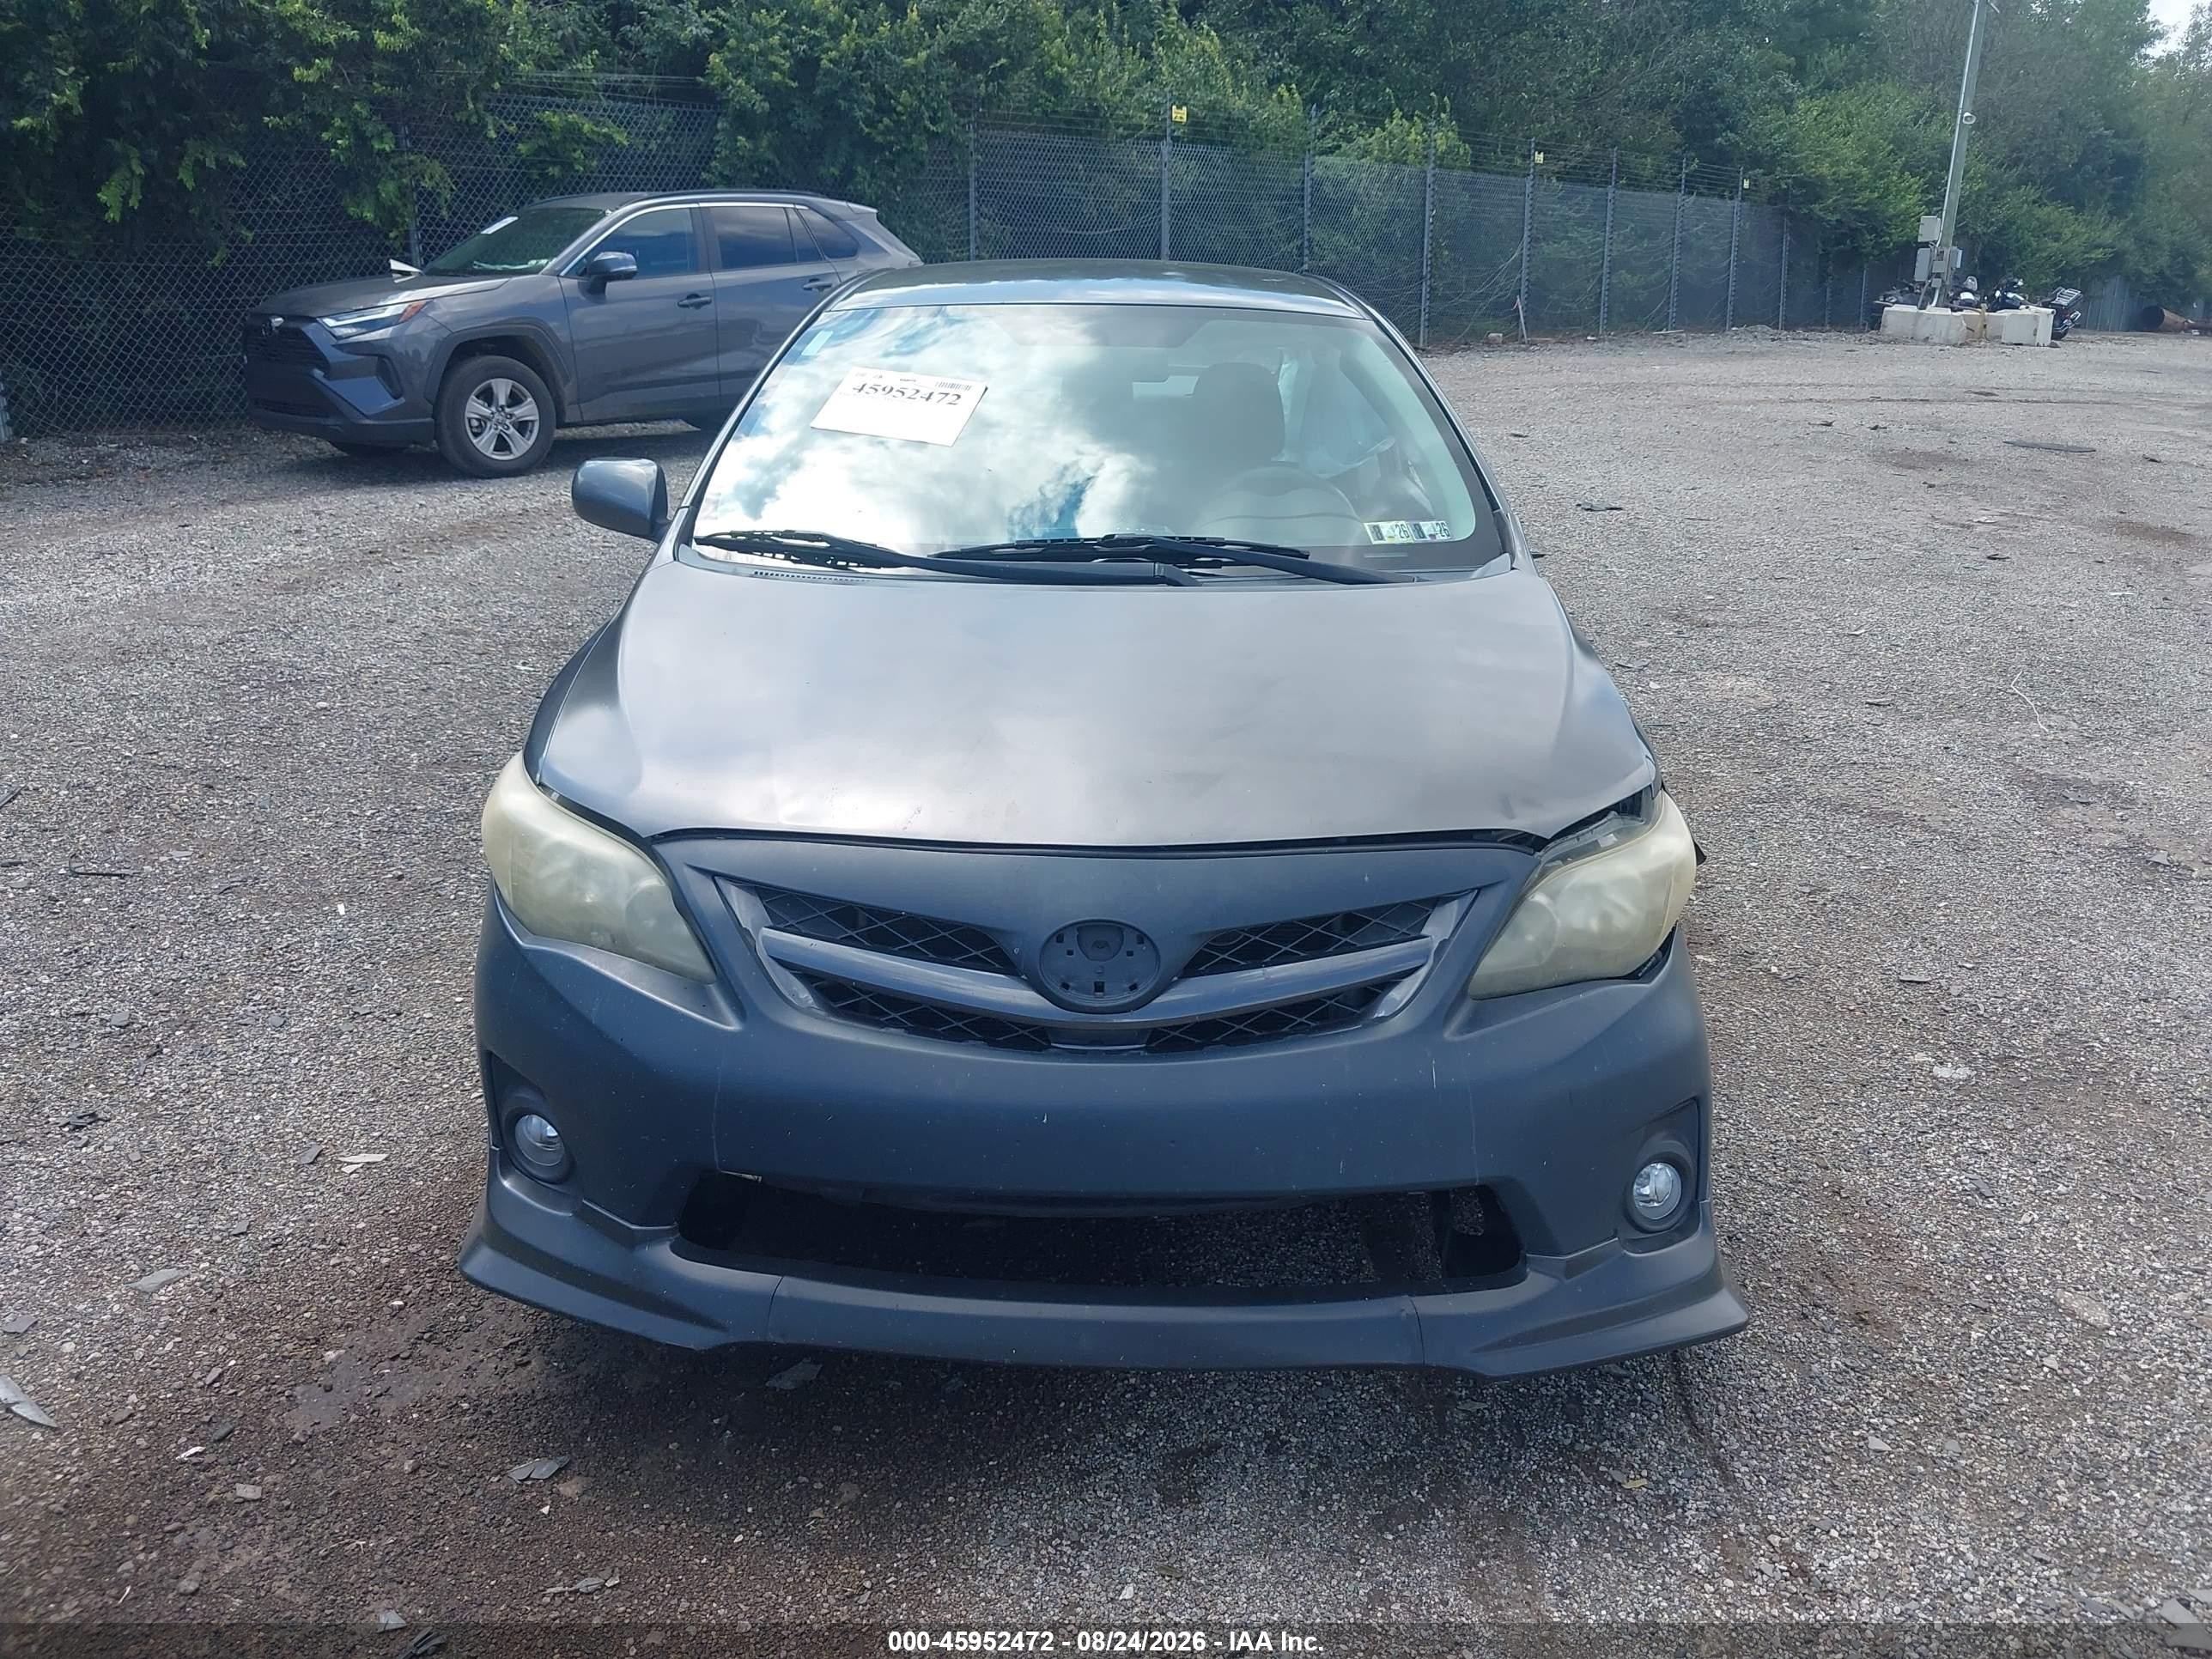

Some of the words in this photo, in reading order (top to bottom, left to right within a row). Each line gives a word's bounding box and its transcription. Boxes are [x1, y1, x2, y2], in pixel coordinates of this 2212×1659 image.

[852, 382, 962, 406] 45952472
[1395, 523, 1410, 539] 26
[1414, 523, 1426, 539] 8
[1436, 521, 1451, 538] 26
